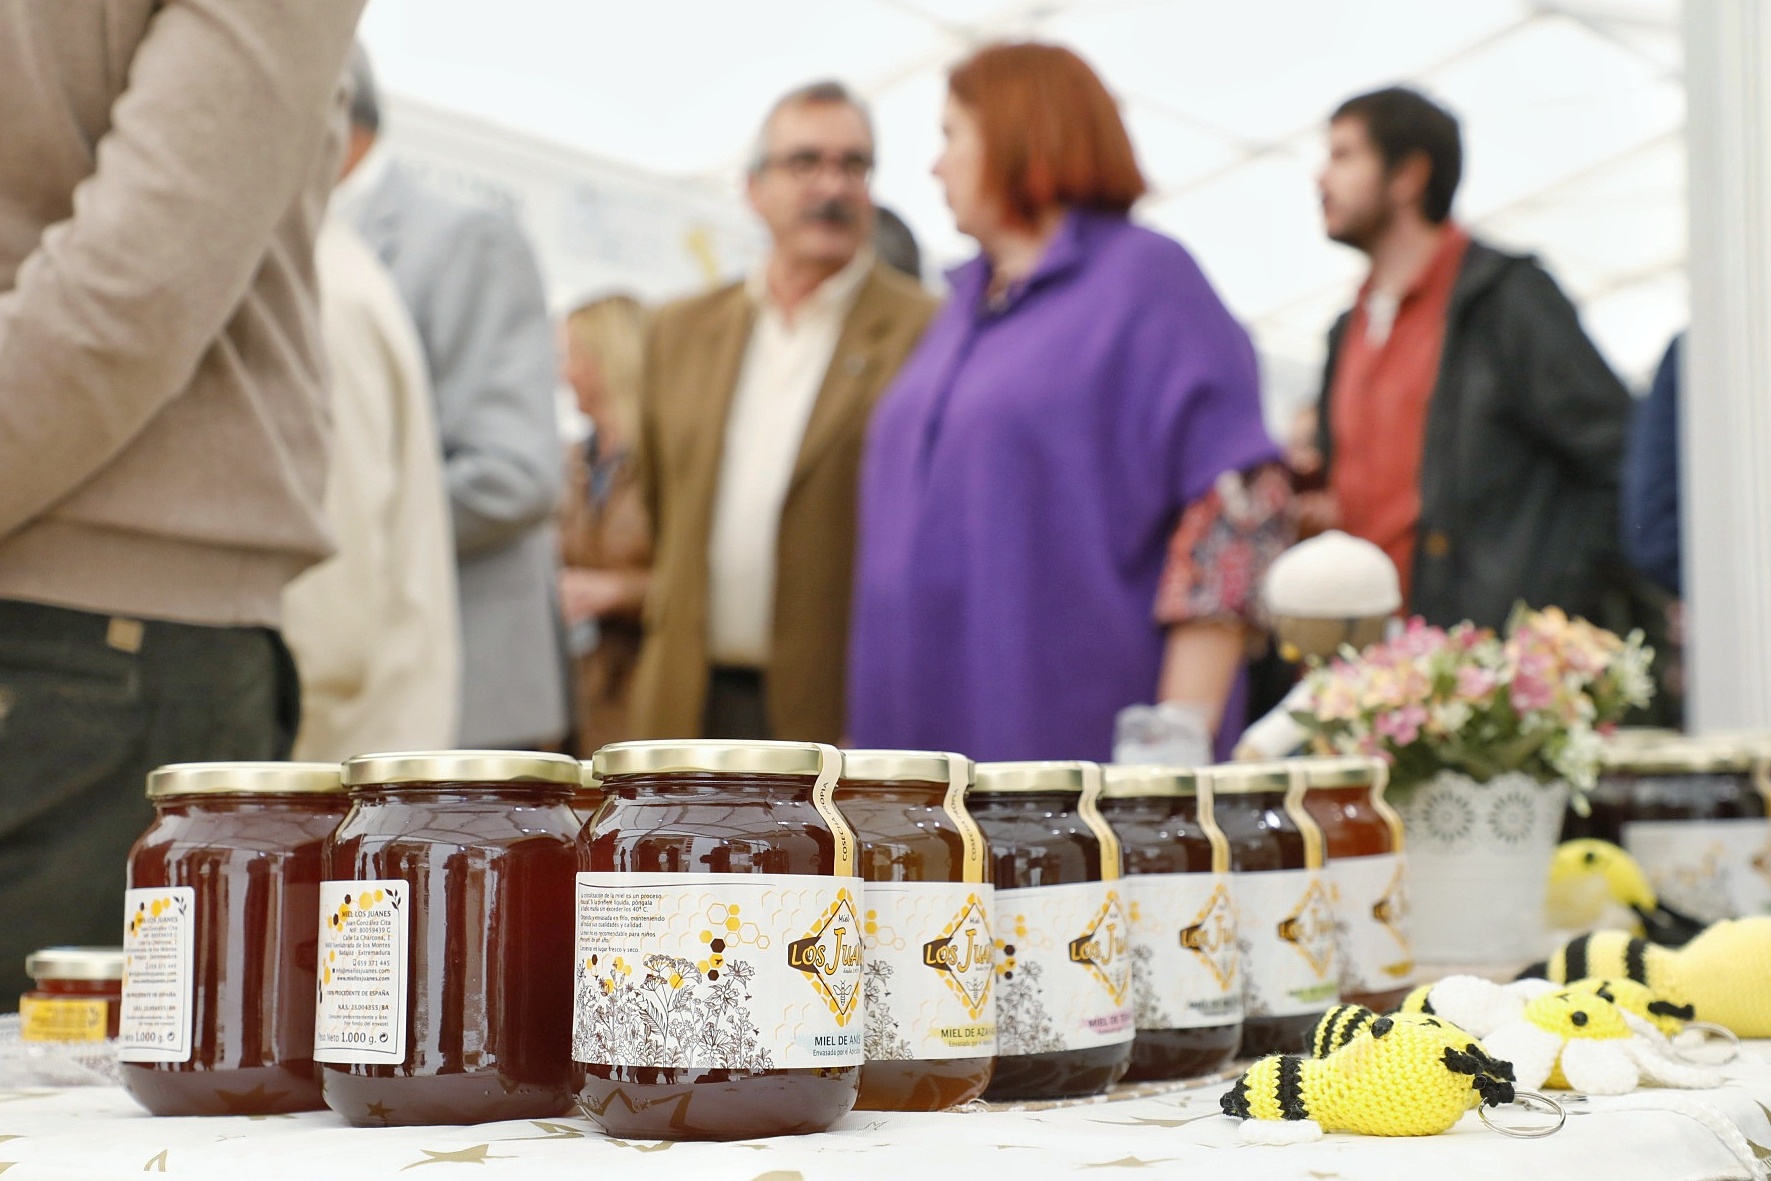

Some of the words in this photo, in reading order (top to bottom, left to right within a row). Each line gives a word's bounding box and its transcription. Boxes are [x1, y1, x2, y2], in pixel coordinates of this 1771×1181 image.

[819, 782, 832, 815] PROPIA
[831, 817, 848, 862] COSECHA
[838, 914, 850, 922] Miel
[791, 944, 826, 967] LOS
[926, 944, 958, 965] LOS
[1071, 941, 1100, 960] LOS
[341, 1032, 366, 1043] 1.000
[814, 1036, 836, 1046] MIEL
[838, 1035, 848, 1046] DE
[941, 1028, 963, 1038] MIEL
[965, 1028, 975, 1037] DE
